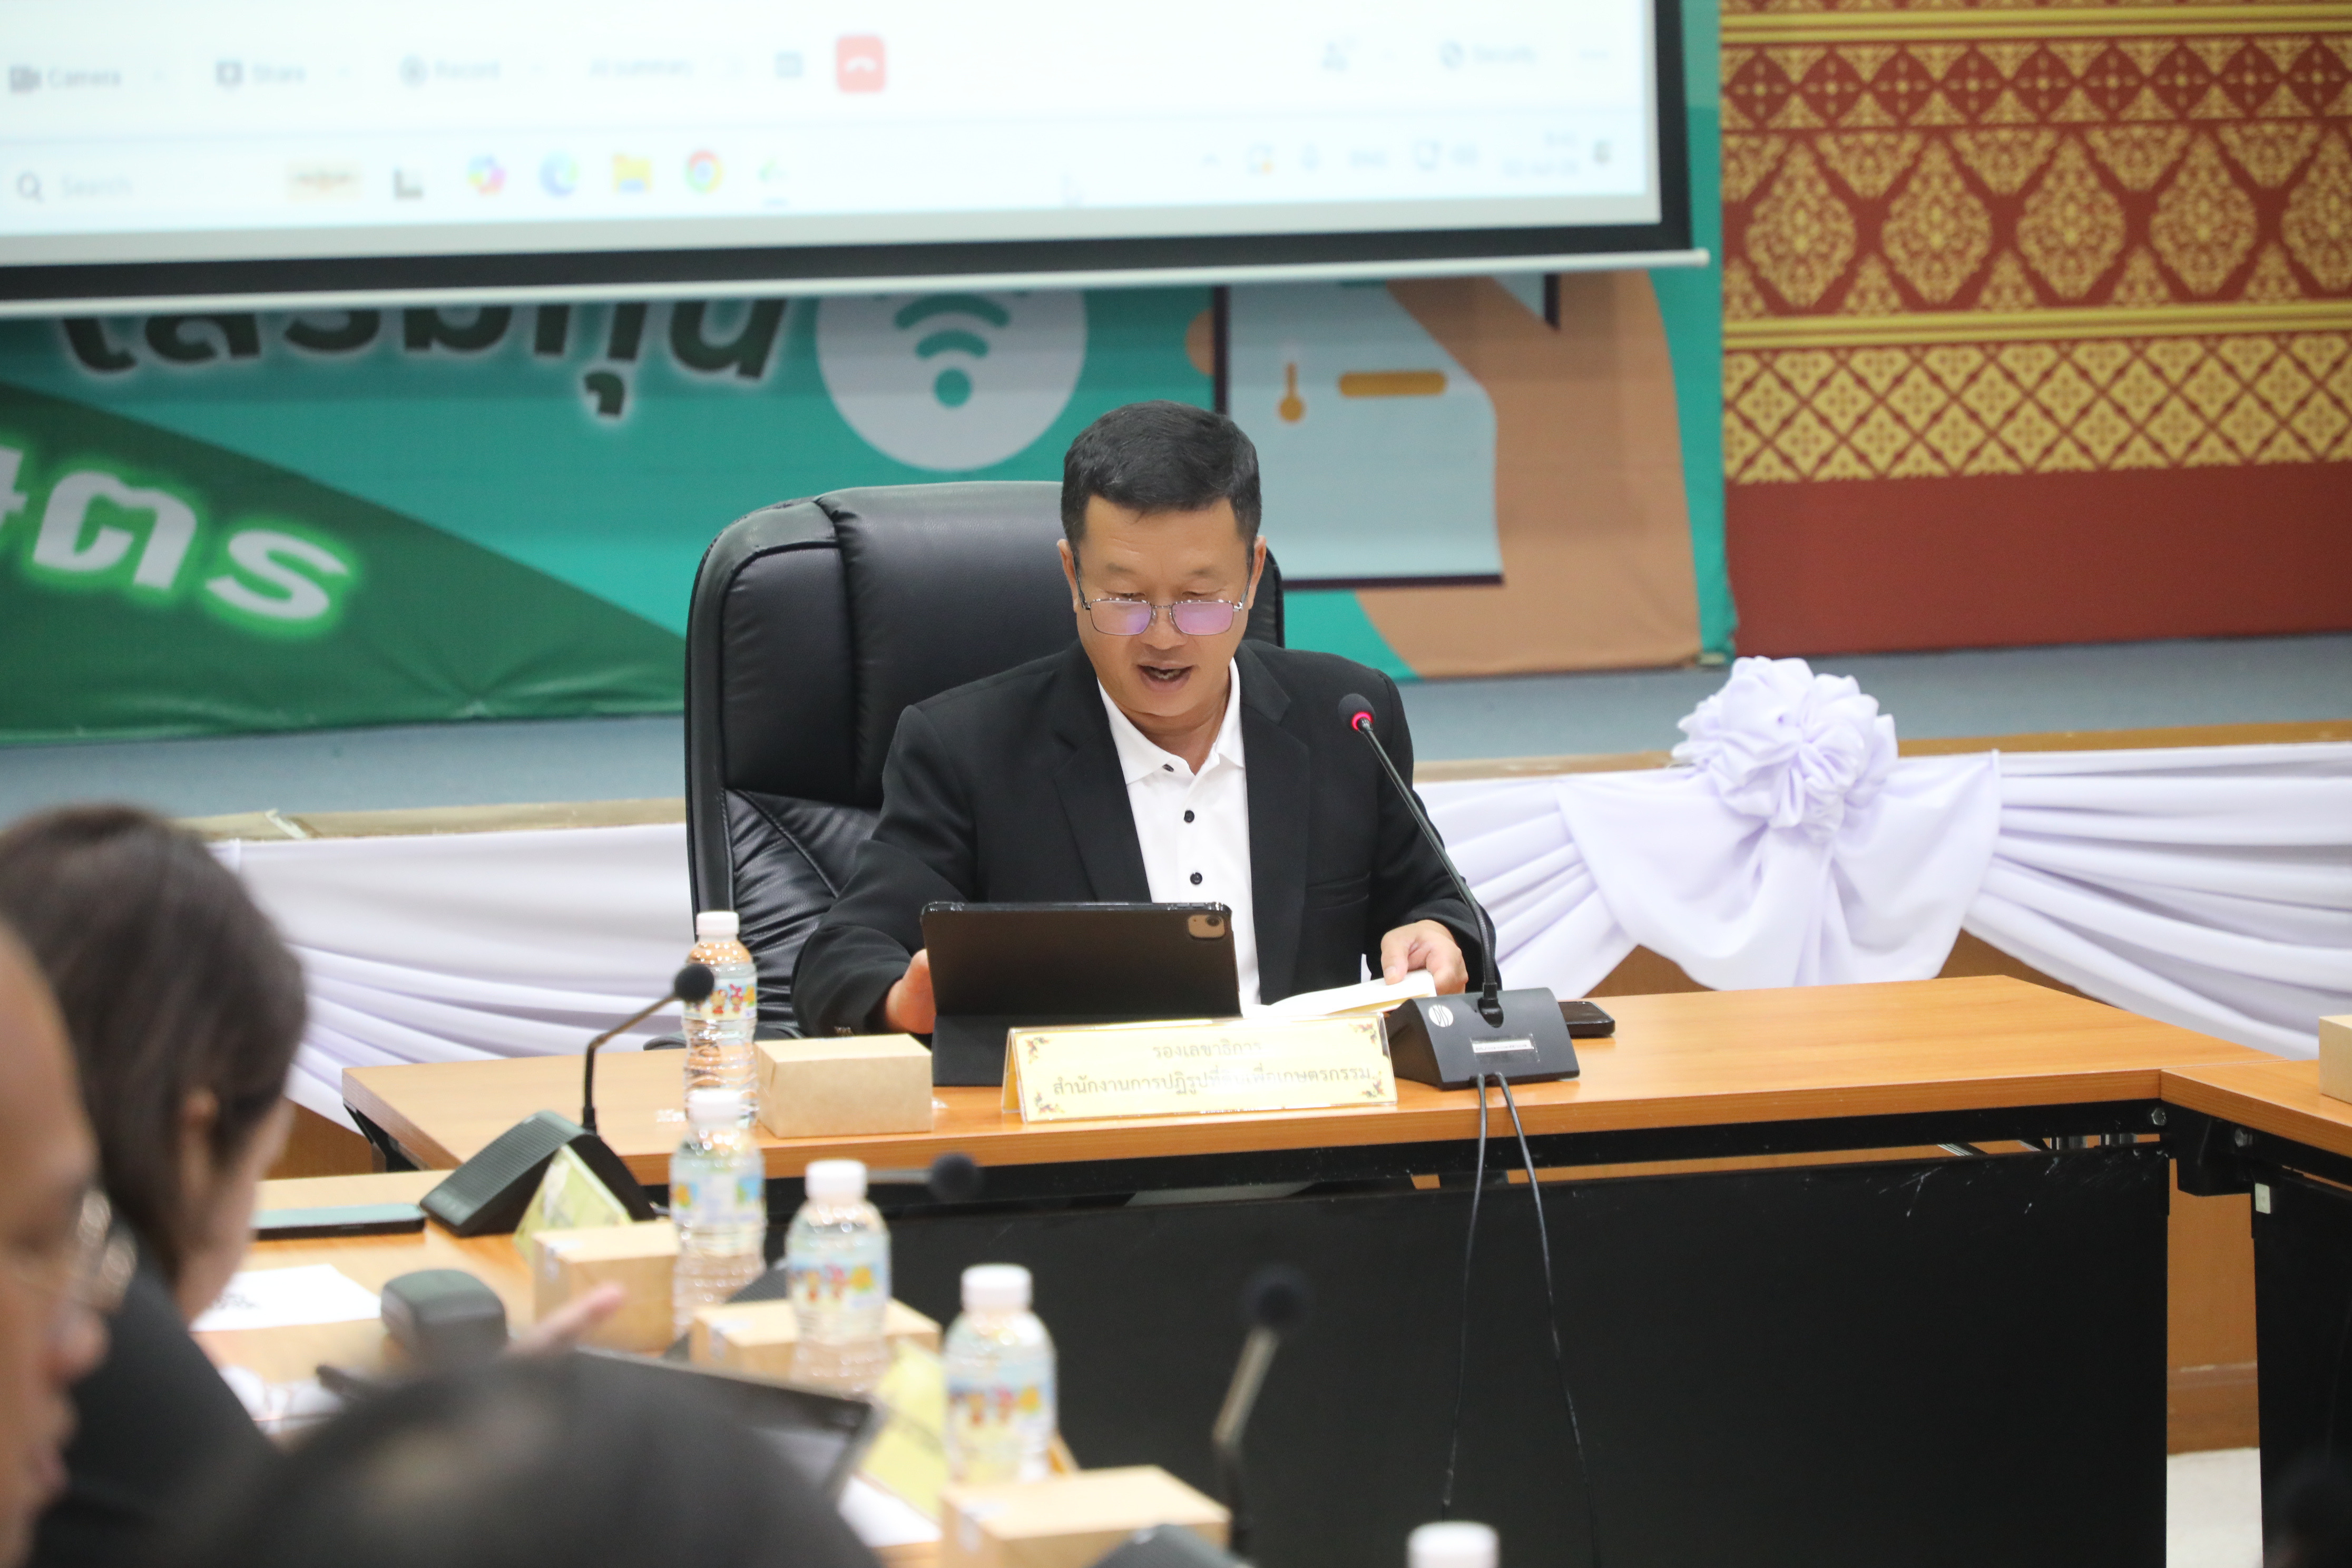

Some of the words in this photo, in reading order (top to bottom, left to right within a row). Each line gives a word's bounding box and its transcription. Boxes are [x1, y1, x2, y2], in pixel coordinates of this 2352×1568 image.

[48, 67, 122, 89] Camera
[253, 61, 307, 84] Share
[435, 57, 501, 80] Record
[61, 173, 132, 196] Search
[1153, 1038, 1261, 1058] รองเลขาธิการ
